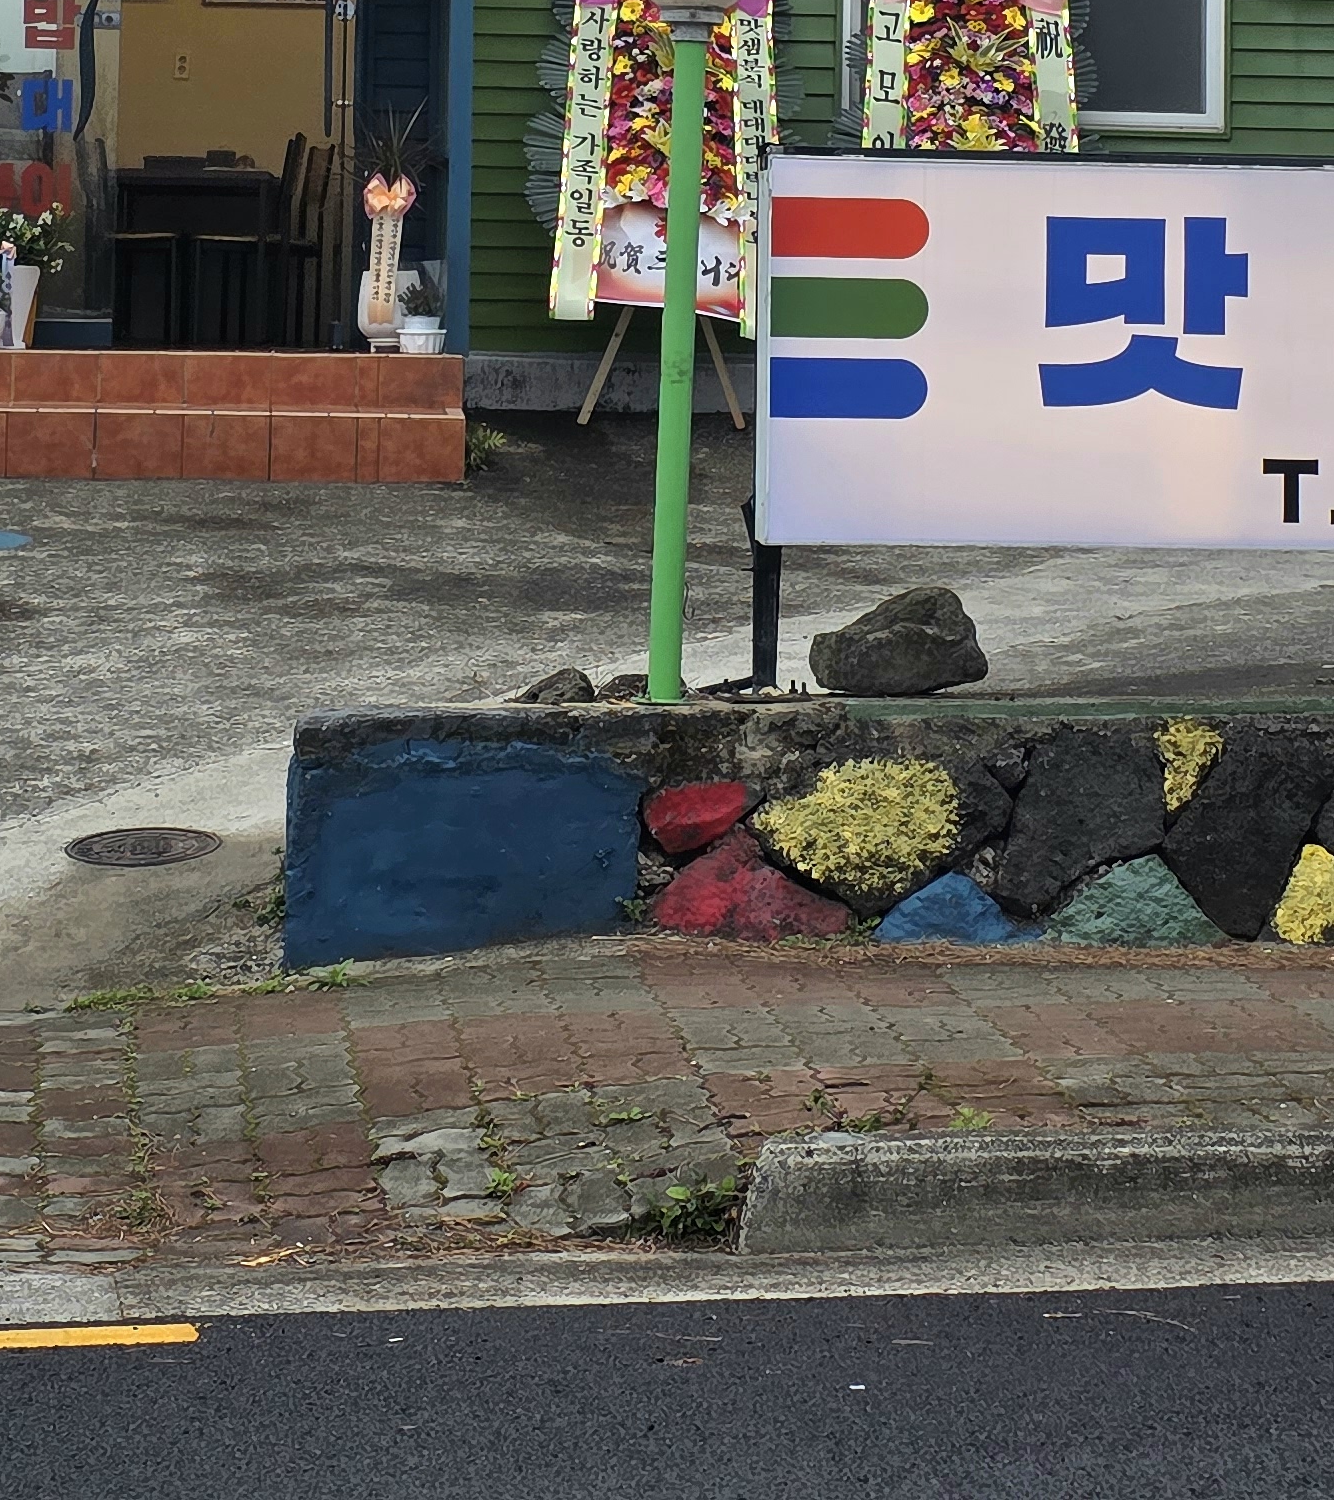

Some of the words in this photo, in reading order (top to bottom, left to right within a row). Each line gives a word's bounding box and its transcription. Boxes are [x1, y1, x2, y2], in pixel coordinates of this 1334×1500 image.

[574, 7, 610, 118] 사랑하는
[738, 18, 765, 89] 맛샘분식
[565, 133, 601, 247] 가족일동
